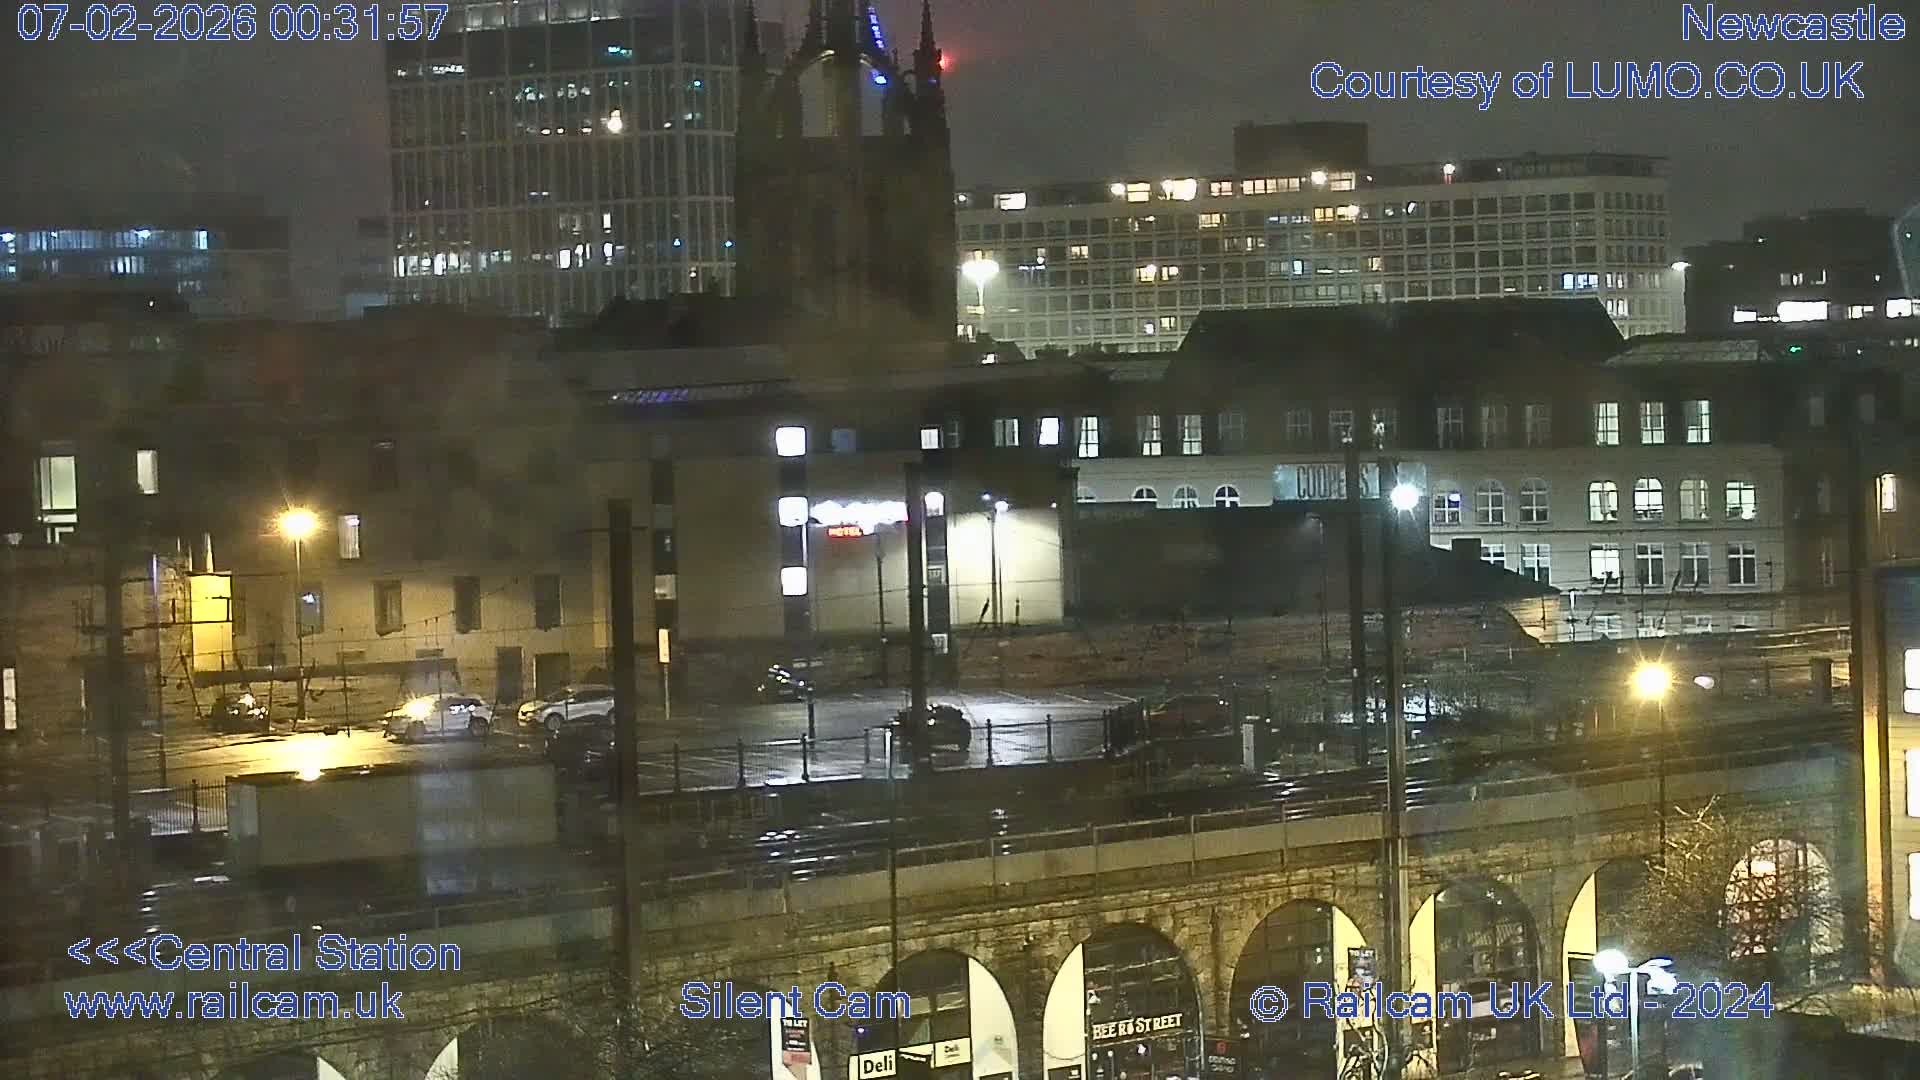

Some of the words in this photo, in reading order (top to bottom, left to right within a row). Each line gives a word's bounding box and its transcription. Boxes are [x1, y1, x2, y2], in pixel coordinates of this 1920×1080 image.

[1297, 465, 1369, 498] COOPES
[1092, 1018, 1129, 1040] BEER
[1135, 1012, 1183, 1033] STREET
[863, 1054, 893, 1075] Deli
